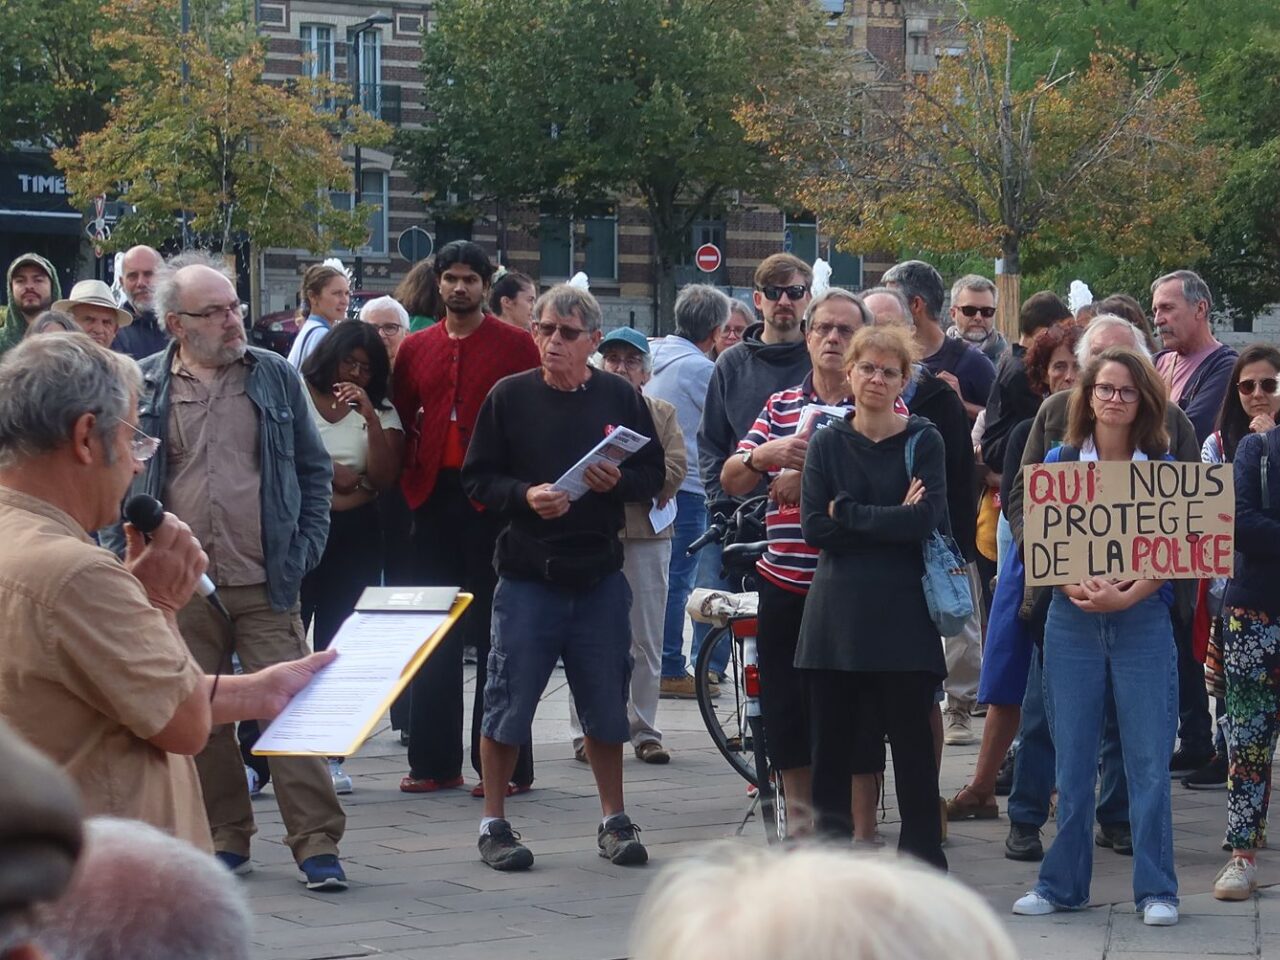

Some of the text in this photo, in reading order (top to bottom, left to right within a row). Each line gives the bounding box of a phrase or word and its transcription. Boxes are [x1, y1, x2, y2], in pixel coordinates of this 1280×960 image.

[1130, 463, 1225, 500] NOUS
[1043, 501, 1204, 539] PROTEGE
[1032, 541, 1070, 579] DE
[1088, 539, 1124, 576] LA
